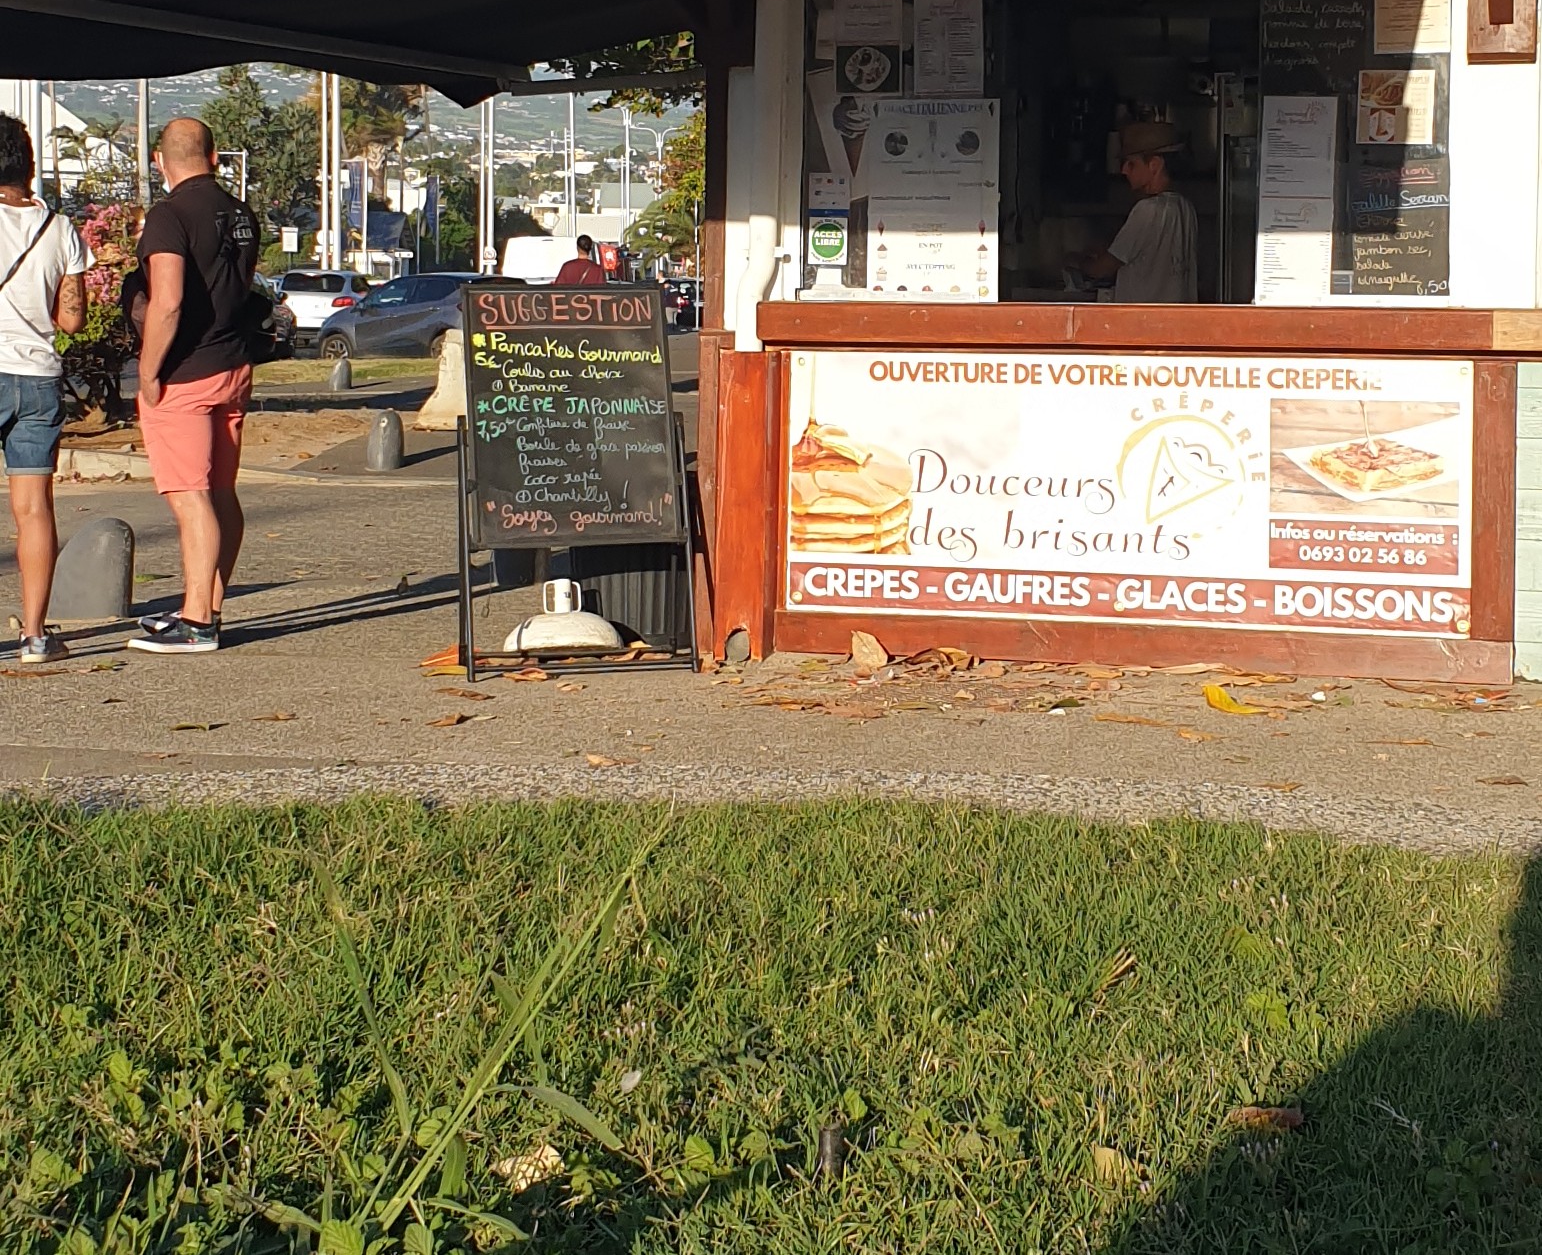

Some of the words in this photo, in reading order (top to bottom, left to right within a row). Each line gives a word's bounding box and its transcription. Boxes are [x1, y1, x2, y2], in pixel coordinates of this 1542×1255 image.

[479, 294, 651, 324] SUGGESTION
[502, 360, 546, 379] Coulis
[549, 368, 573, 378] au
[580, 365, 625, 380] choix
[869, 360, 1008, 384] OUVERTURE
[1014, 363, 1042, 385] DE
[1047, 364, 1128, 386] VOTRE
[1134, 365, 1261, 388] NOUVELLE
[509, 379, 571, 394] Banane
[492, 395, 556, 414] CRÊPE
[572, 418, 589, 429] de
[516, 436, 561, 453] Boule
[565, 443, 582, 453] de
[524, 476, 559, 486] coco
[908, 449, 1115, 514] Douceurs
[534, 485, 612, 512] Chantilly
[909, 507, 977, 562] des
[1003, 509, 1191, 561] brisants
[1270, 522, 1310, 540] Infos
[1313, 528, 1336, 541] ou
[1338, 525, 1446, 545] réservations
[1299, 545, 1345, 563] 0693
[1348, 547, 1373, 564] 02
[1377, 548, 1400, 565] 56
[1403, 549, 1428, 566] 86
[803, 566, 920, 600] CREPES
[943, 571, 1092, 607] GAUFRES
[1115, 578, 1247, 614] GLACES
[1274, 584, 1455, 624] BOISSONS
